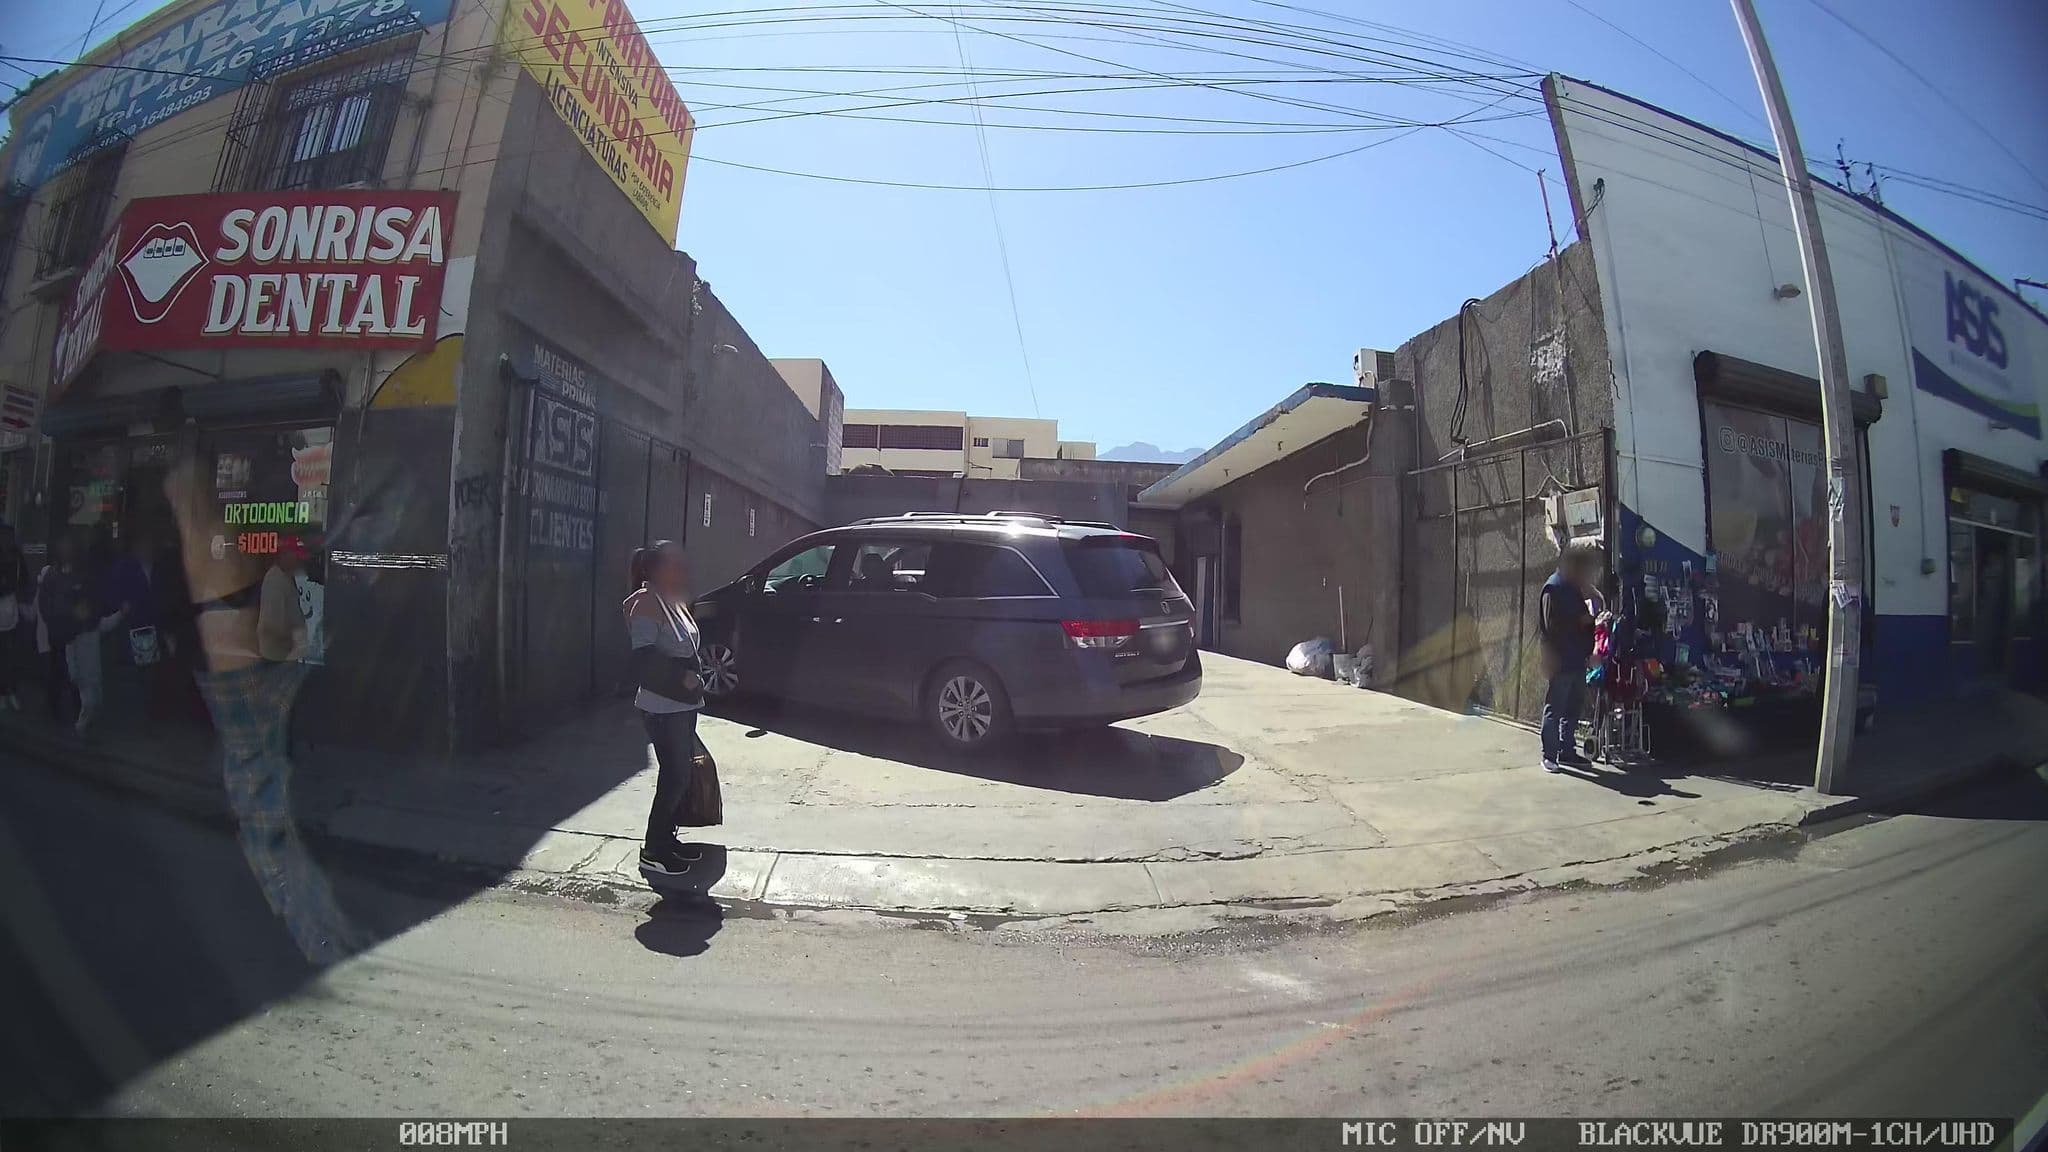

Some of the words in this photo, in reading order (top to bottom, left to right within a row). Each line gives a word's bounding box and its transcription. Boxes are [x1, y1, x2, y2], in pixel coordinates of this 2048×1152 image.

[157, 0, 405, 101] 4646-1378
[589, 0, 690, 147] ARATORIA
[596, 39, 638, 110] INTENSIVA
[543, 68, 629, 184] LICENCIATURAS
[215, 205, 444, 264] SONRISA
[203, 273, 427, 336] DENTAL
[1944, 270, 2009, 370] ASIS
[533, 344, 586, 389] MATERIAS
[534, 398, 594, 475] ASIS
[224, 501, 309, 525] ORTODONCIA
[238, 531, 278, 555] $1000
